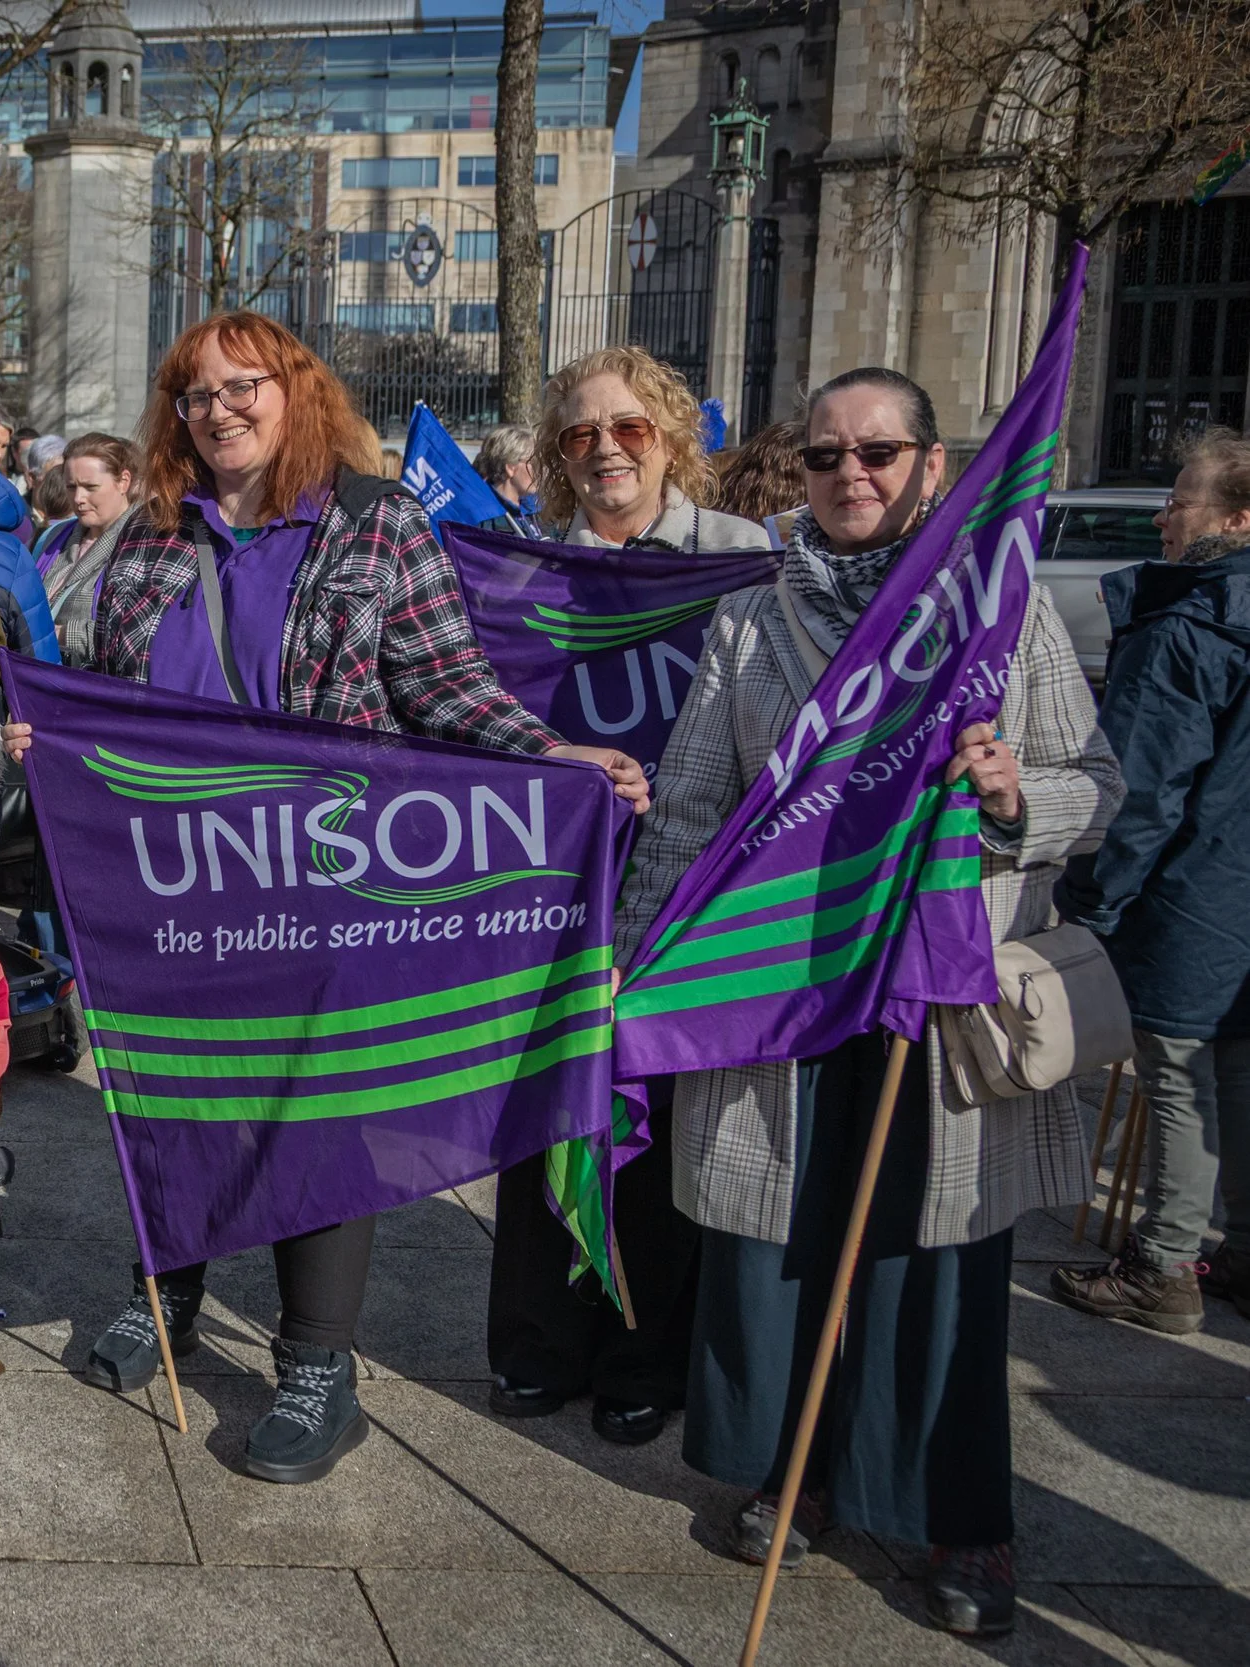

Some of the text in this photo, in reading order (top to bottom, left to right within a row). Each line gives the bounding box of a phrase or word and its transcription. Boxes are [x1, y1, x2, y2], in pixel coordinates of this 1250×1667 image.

[129, 778, 548, 897] UNISON
[153, 897, 587, 962] the public service union
